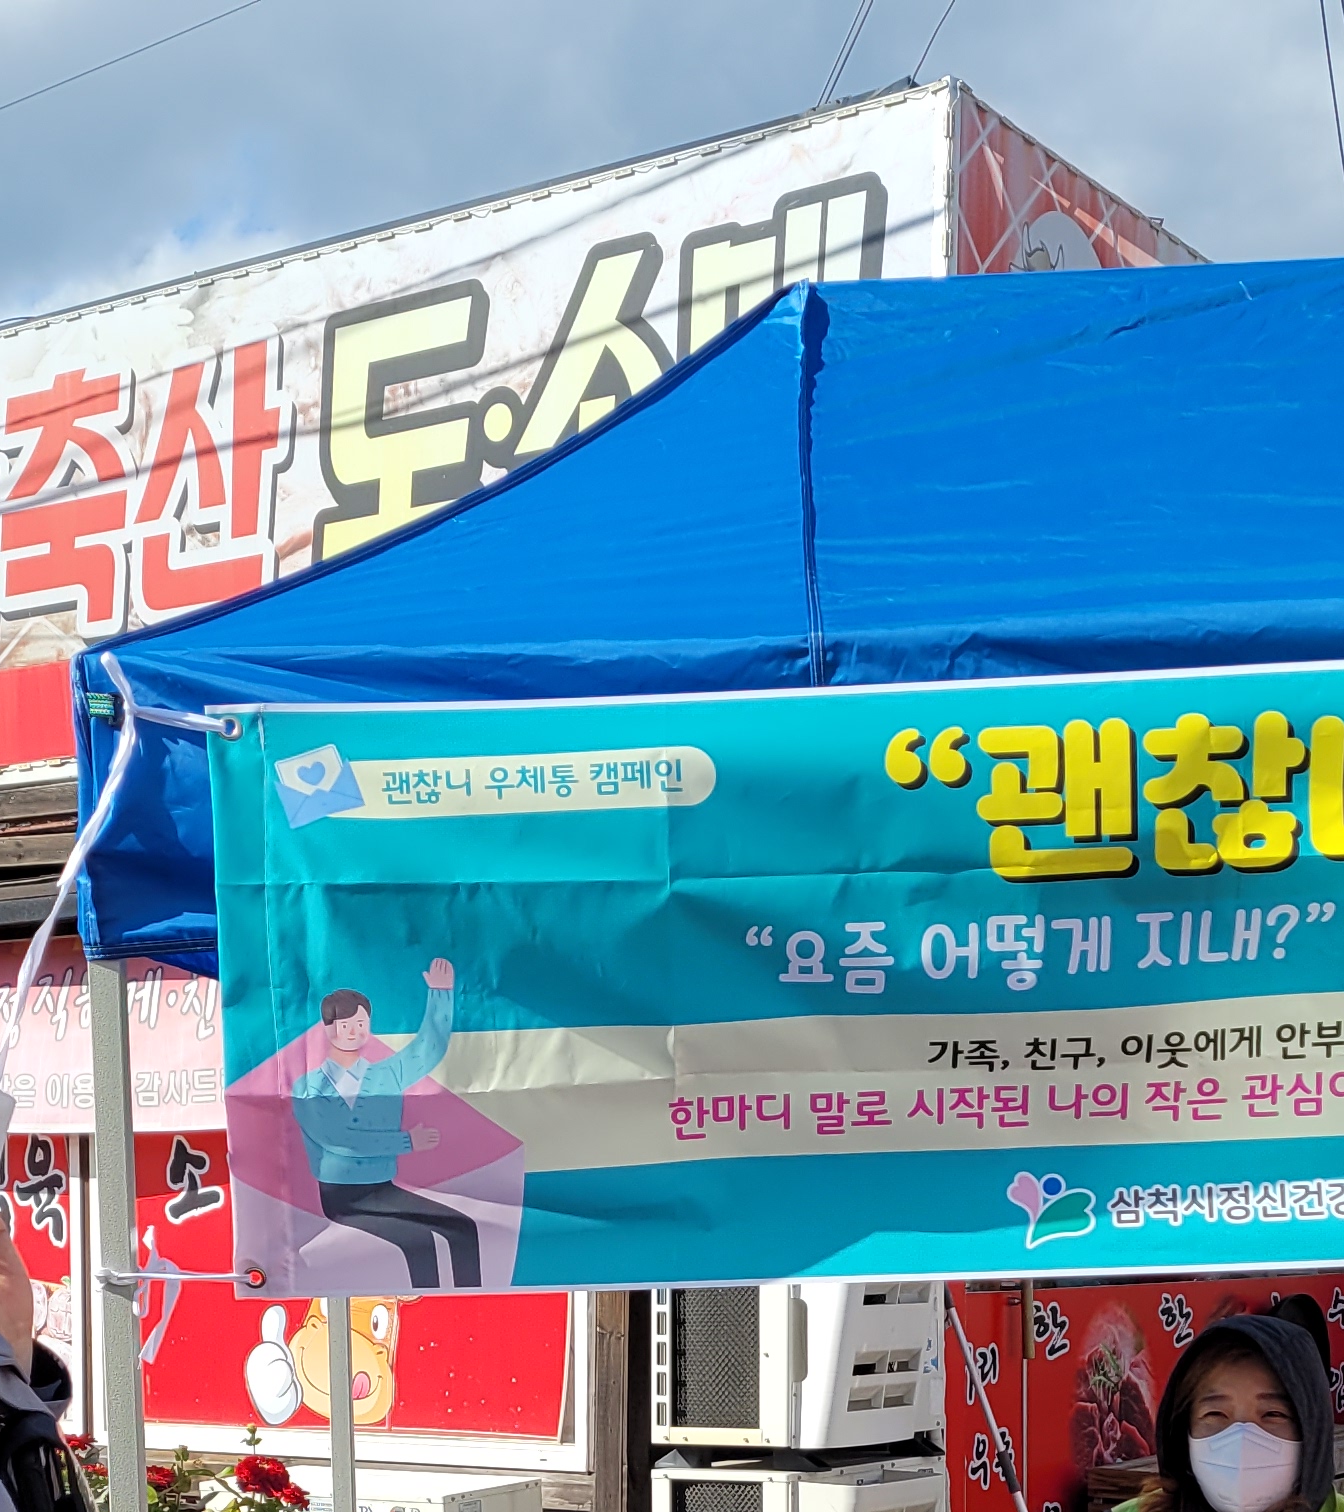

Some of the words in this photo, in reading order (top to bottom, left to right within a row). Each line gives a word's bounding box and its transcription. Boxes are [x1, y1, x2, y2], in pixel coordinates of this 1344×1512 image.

[381, 768, 472, 805] 괜찮니
[484, 763, 580, 800] 우체통
[589, 757, 684, 796] 캠페인
[745, 920, 895, 995] “요즘
[920, 912, 1112, 992] 어떻게
[1137, 902, 1336, 969] 지내?”
[926, 1038, 1010, 1073] 가족,
[1023, 1034, 1107, 1071] 친구,
[1120, 1024, 1263, 1069] 이웃에게
[668, 1091, 792, 1141] 한마디
[809, 1087, 894, 1136] 말로
[907, 1082, 1030, 1130] 시작된
[1047, 1079, 1128, 1121] 나의
[1144, 1075, 1228, 1122] 작은
